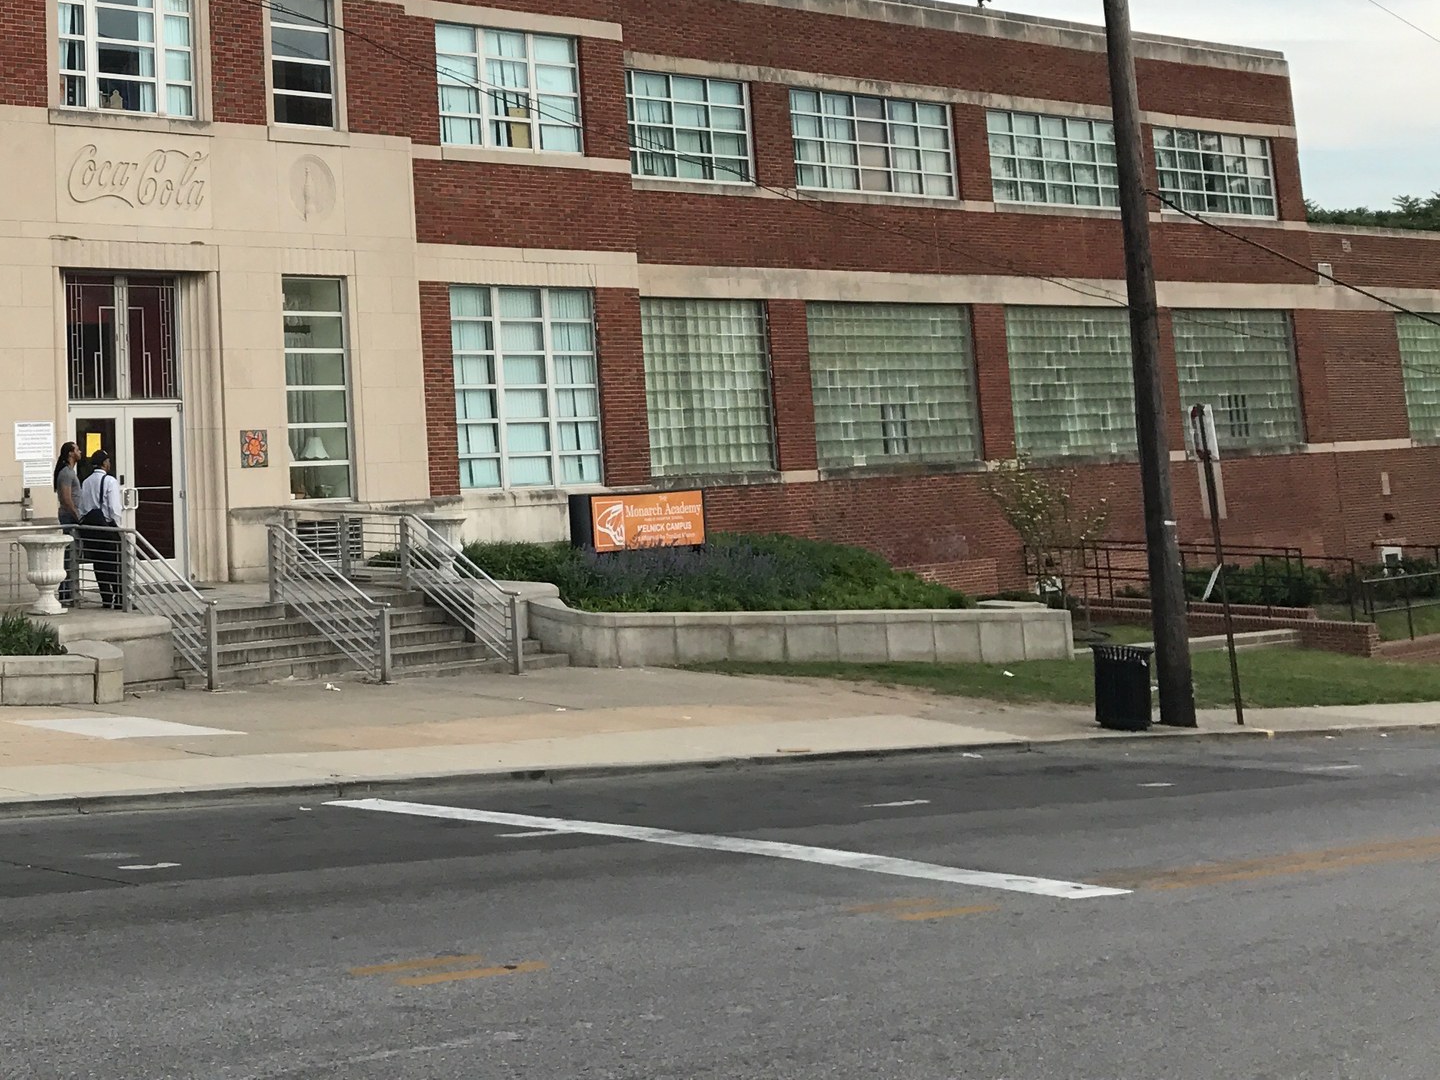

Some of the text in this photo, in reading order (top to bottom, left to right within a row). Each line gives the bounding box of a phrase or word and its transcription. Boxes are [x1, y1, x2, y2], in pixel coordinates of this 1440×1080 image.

[625, 501, 702, 518] Monarch Academy
[666, 521, 692, 531] CAMPUS
